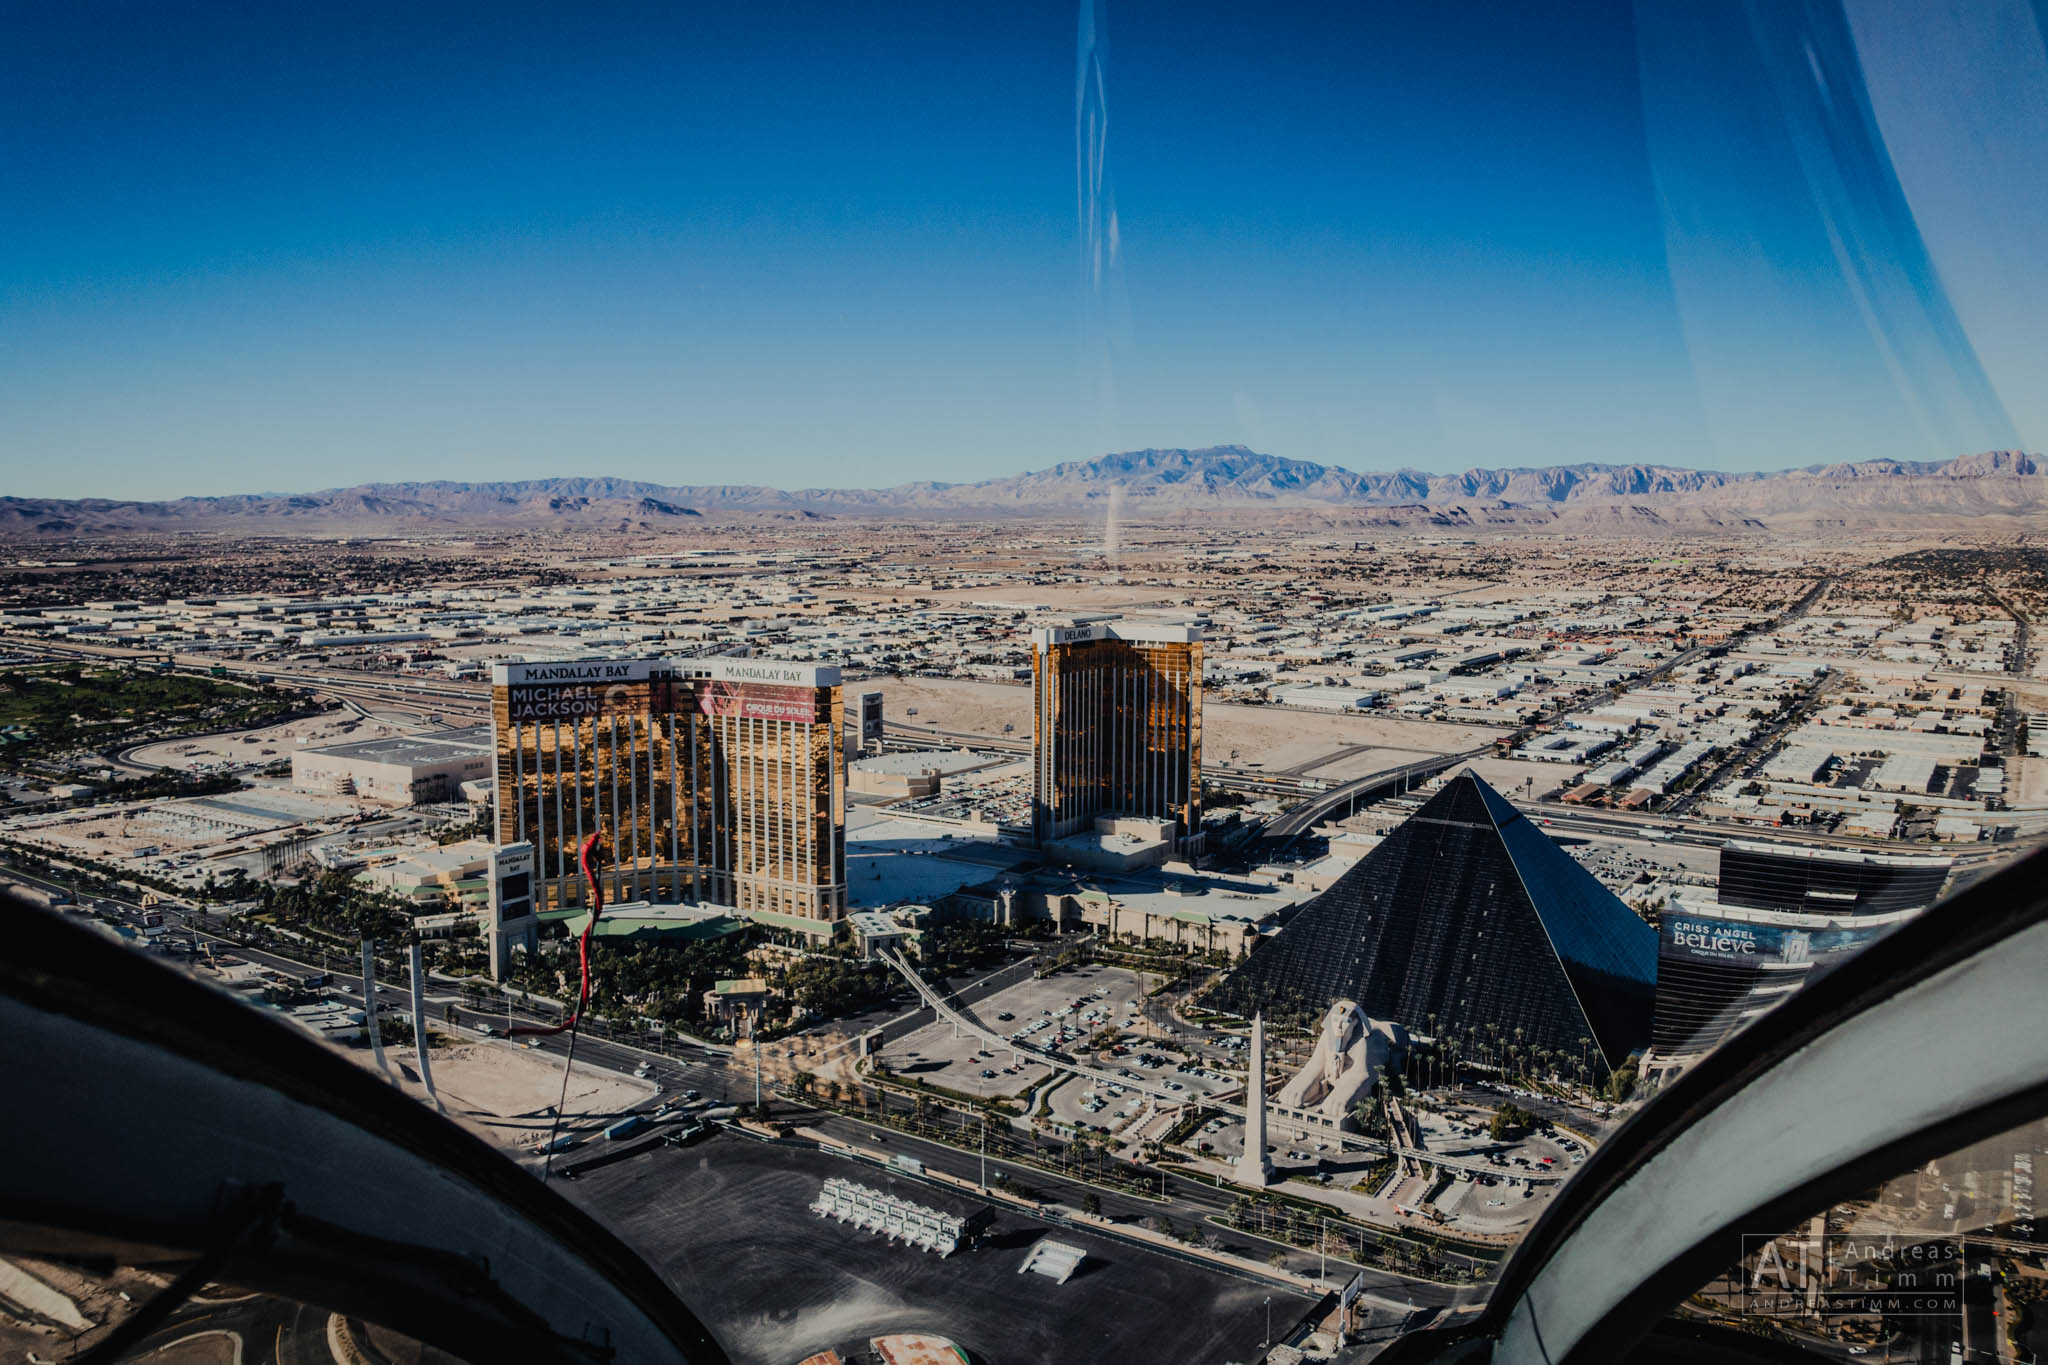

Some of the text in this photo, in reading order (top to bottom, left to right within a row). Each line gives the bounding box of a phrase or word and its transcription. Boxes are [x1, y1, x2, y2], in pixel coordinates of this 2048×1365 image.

[1065, 630, 1091, 641] DELANO
[525, 665, 630, 680] MANDALAY BAY
[725, 667, 802, 681] MANDALAY BAY
[513, 686, 598, 702] MICHAEL
[513, 700, 598, 717] JACKSON
[746, 704, 772, 714] CIRQUE
[774, 706, 785, 714] DU
[499, 855, 530, 865] MANDALAY
[1674, 922, 1757, 940] CRISS ANGEL
